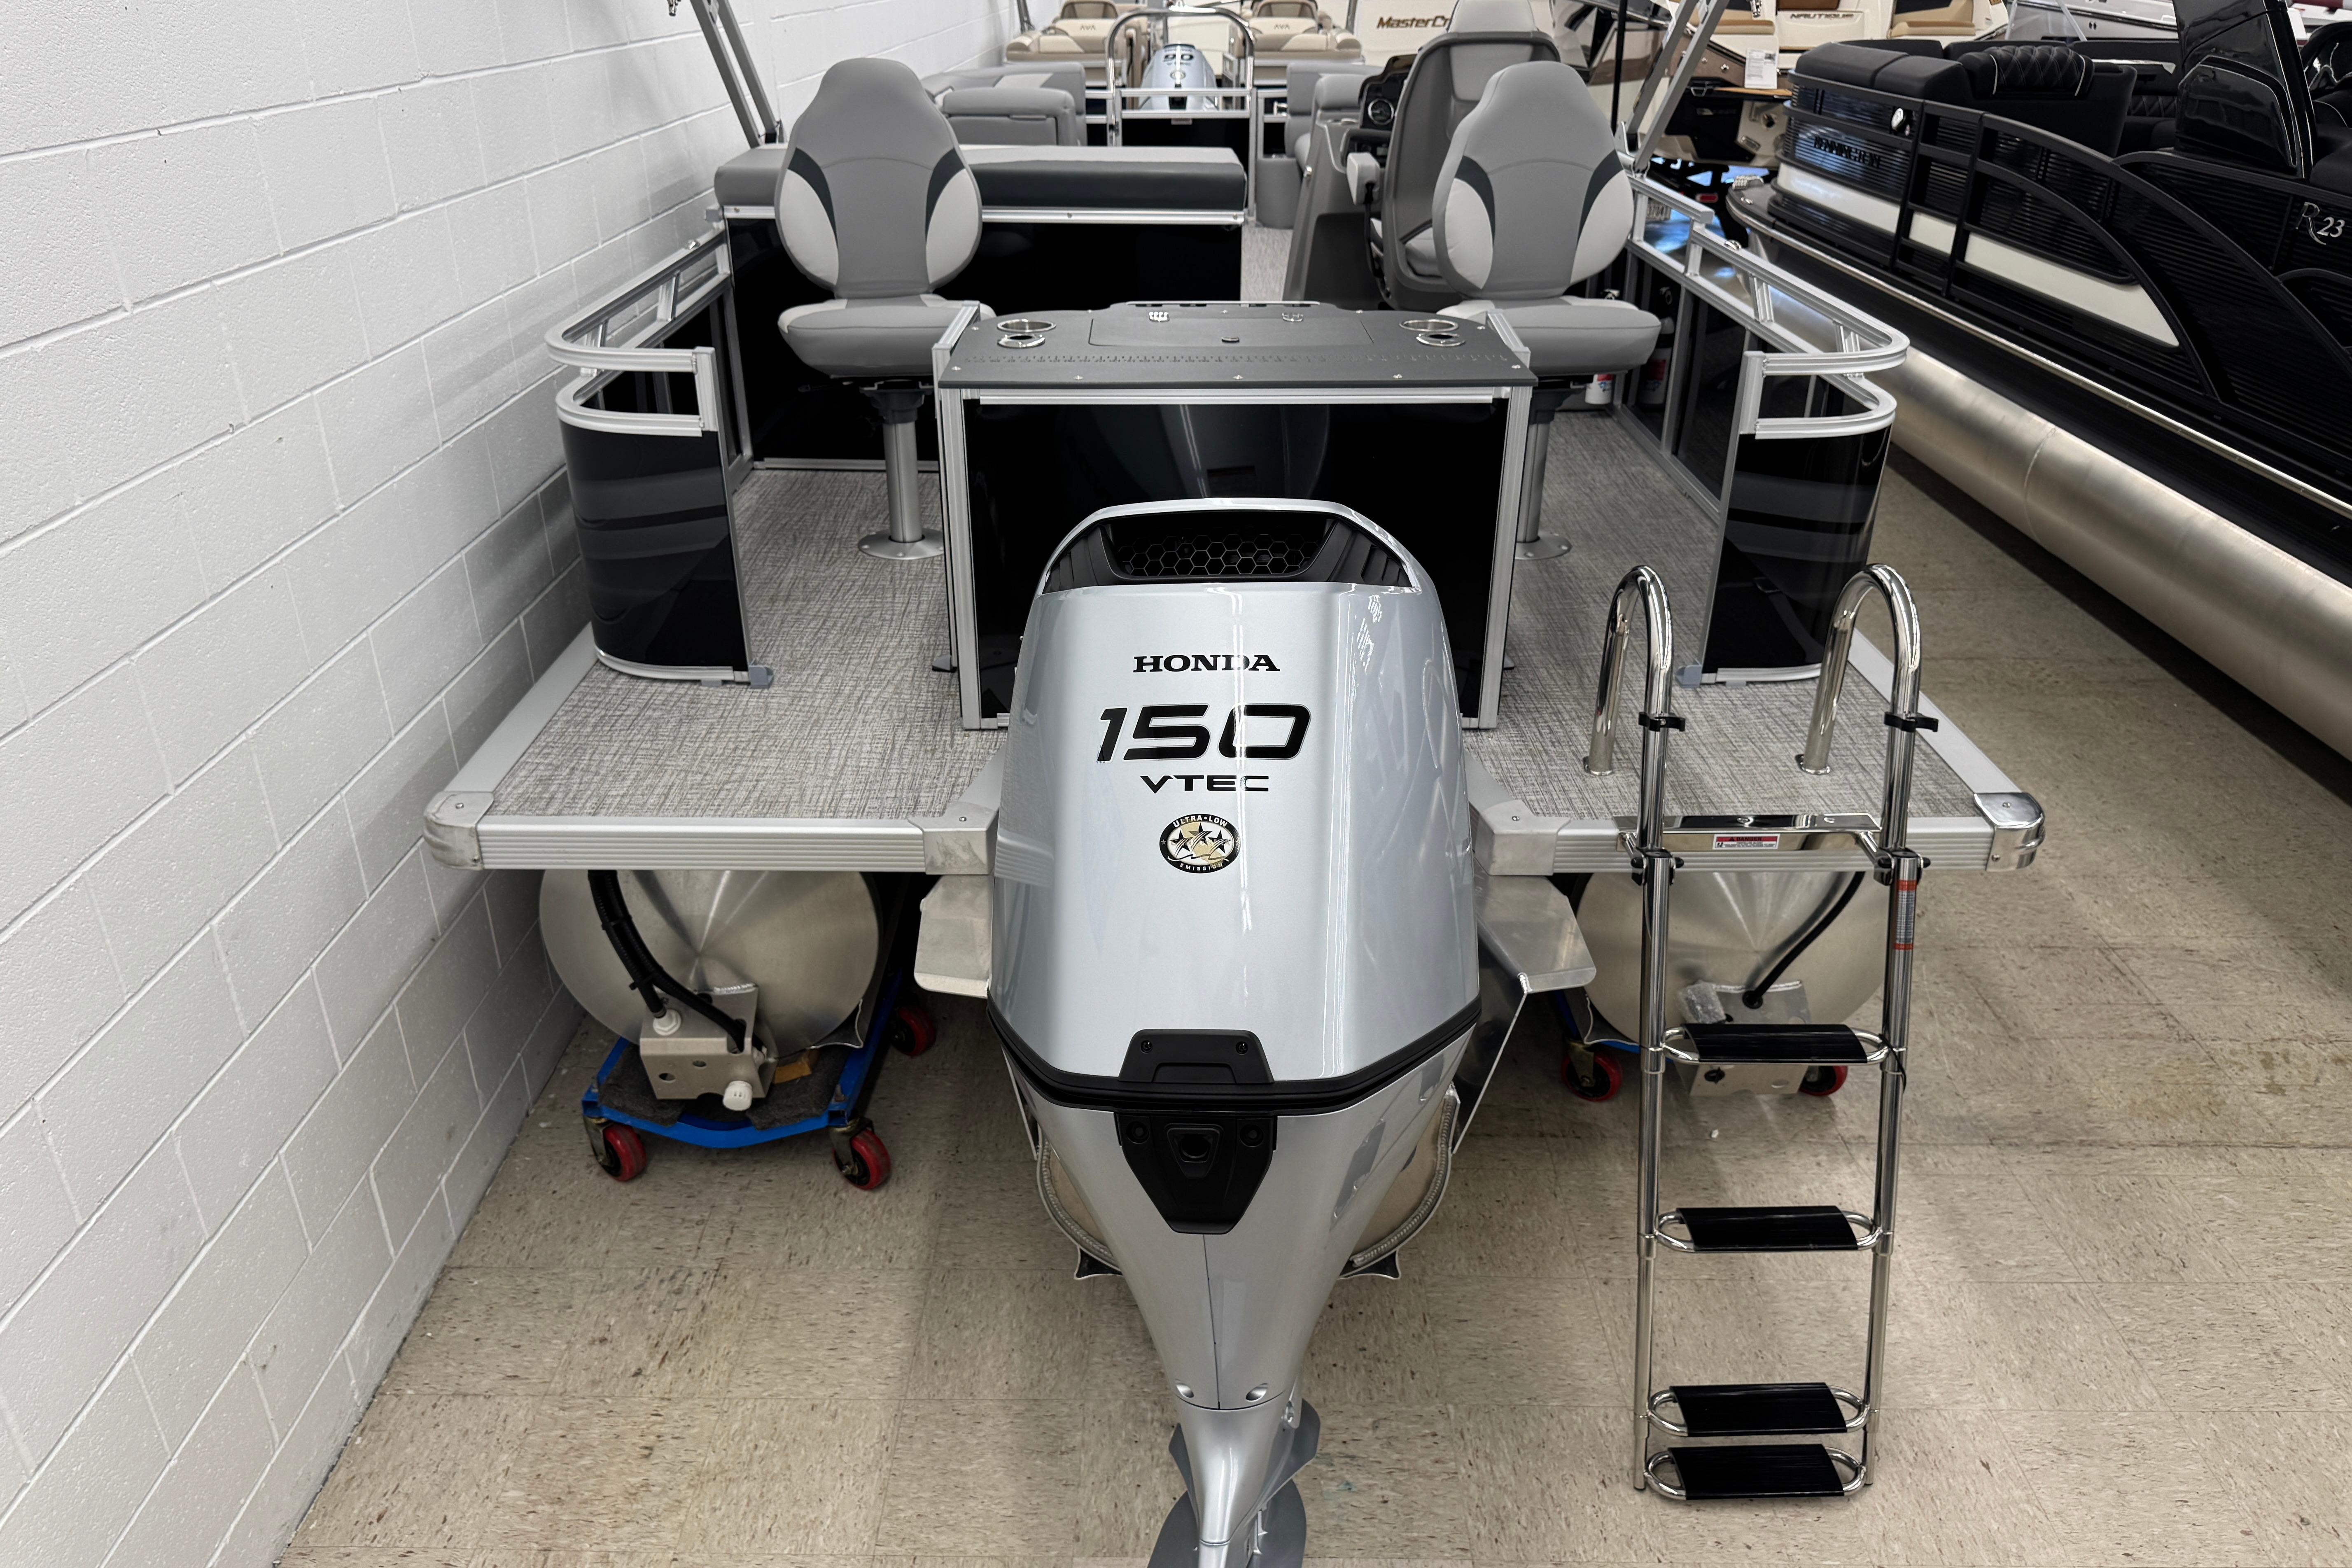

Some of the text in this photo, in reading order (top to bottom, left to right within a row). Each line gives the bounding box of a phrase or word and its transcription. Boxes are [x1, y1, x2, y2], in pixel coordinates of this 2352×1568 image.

[1133, 654, 1280, 672] HONDA
[1097, 703, 1311, 763] 150
[1140, 775, 1269, 794] VTEC
[1180, 862, 1223, 871] EMISSION
